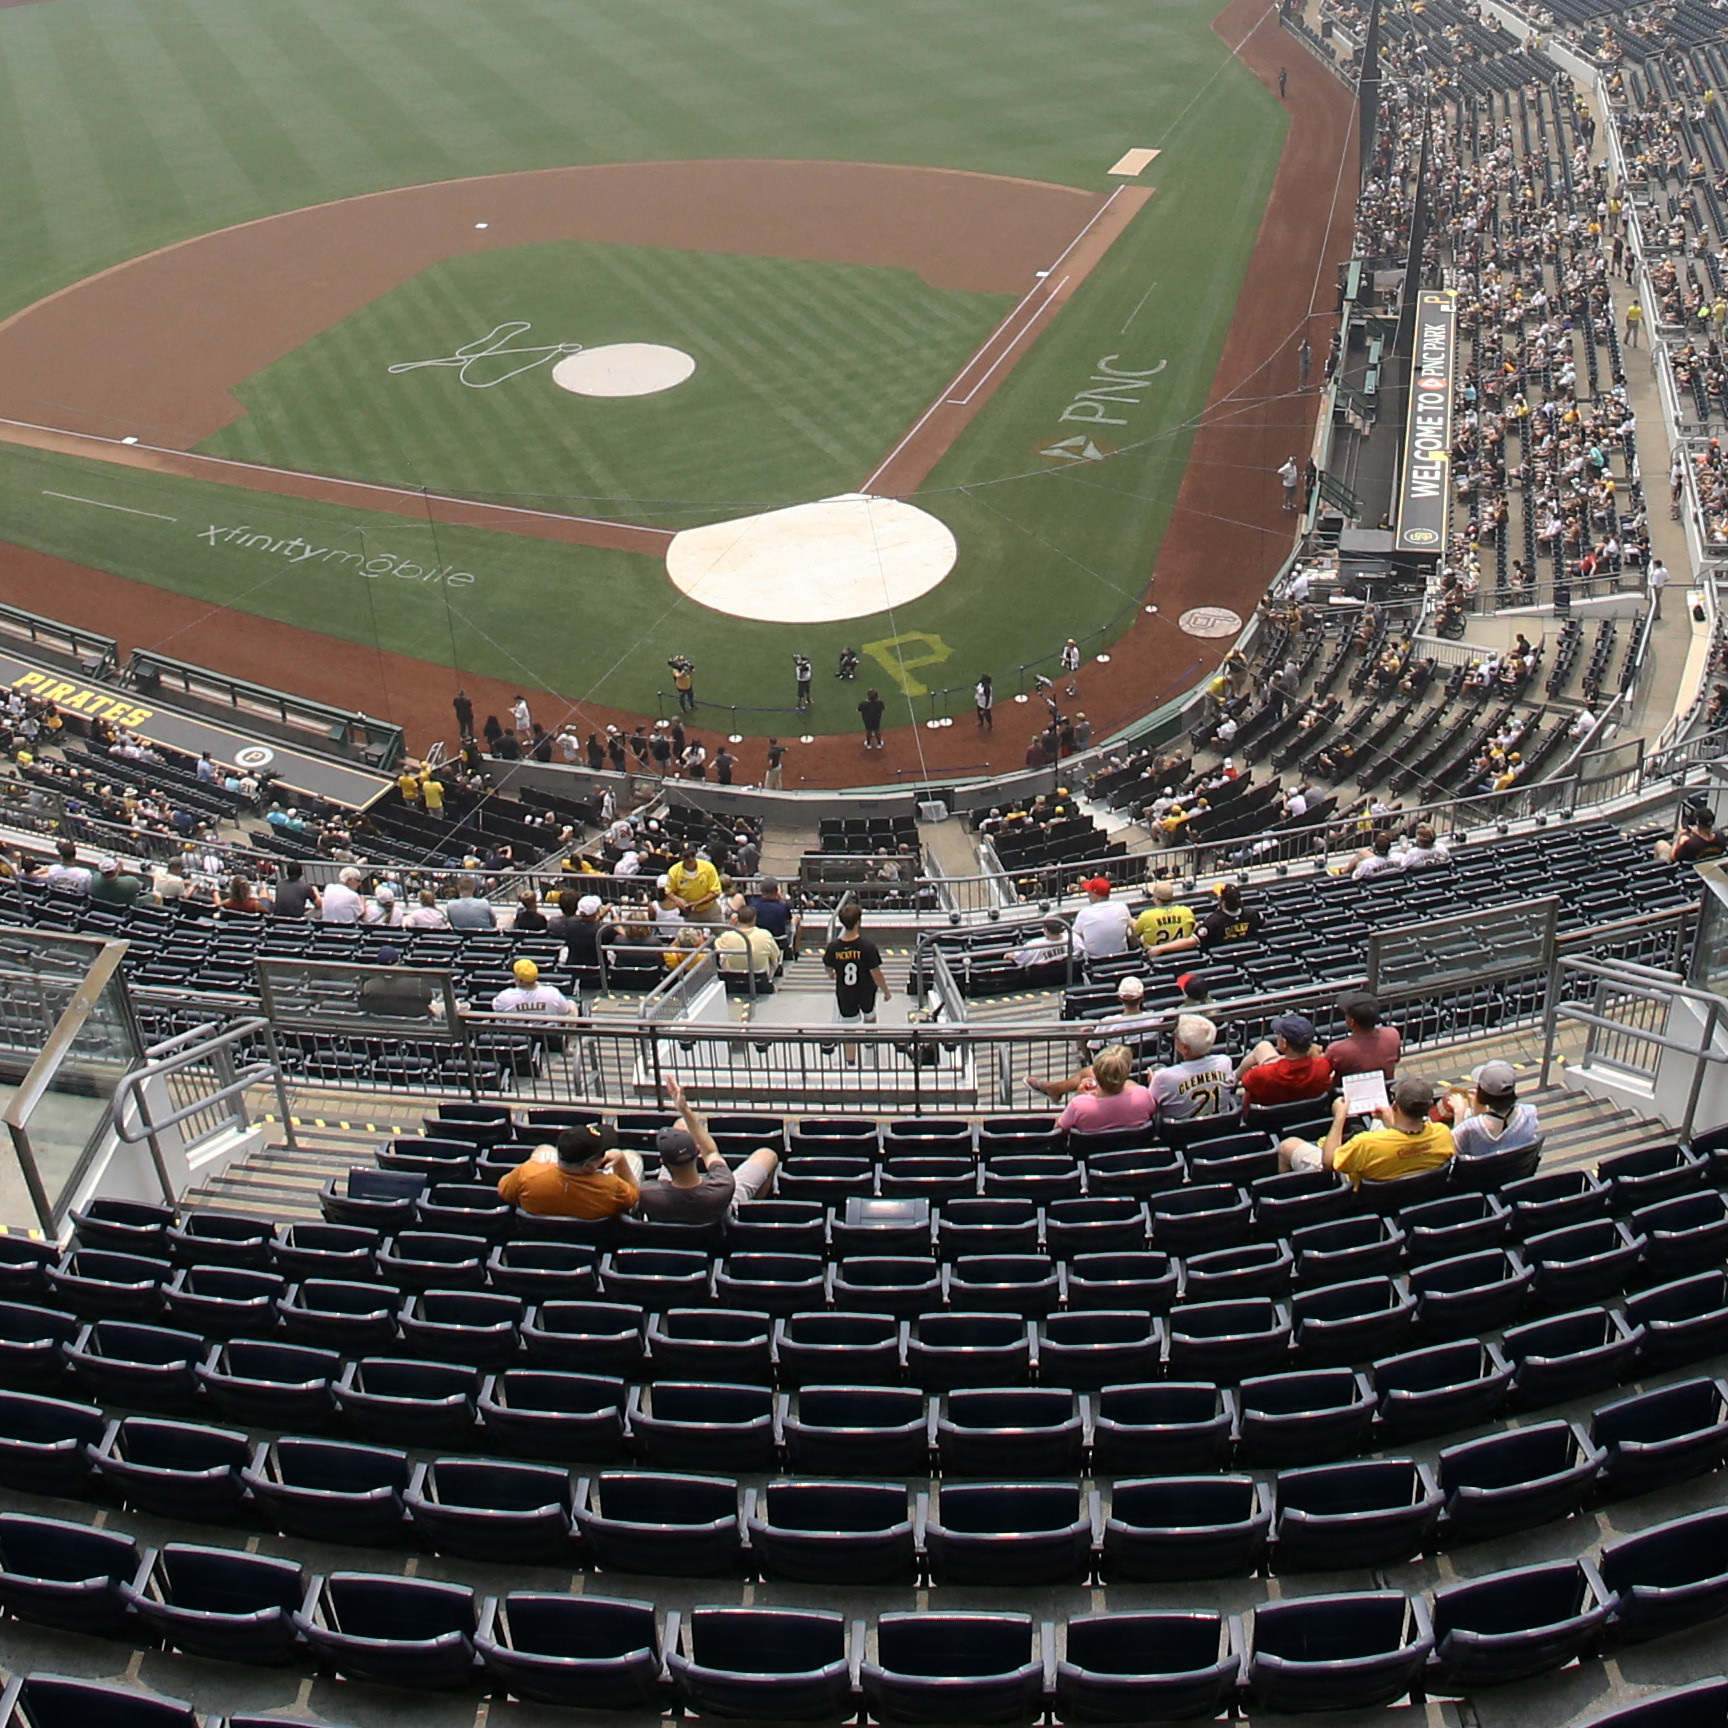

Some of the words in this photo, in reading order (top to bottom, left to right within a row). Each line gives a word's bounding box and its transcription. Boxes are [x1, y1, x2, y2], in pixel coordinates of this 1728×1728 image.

[1424, 323, 1447, 351] PARK
[1421, 353, 1446, 377] PNC
[1058, 354, 1168, 426] PNC
[1418, 392, 1445, 412] TO
[10, 671, 154, 728] PIRATES
[1155, 927, 1185, 945] 24
[844, 962, 858, 986] 8
[516, 1001, 546, 1012] KELLER
[1190, 1084, 1222, 1118] 21
